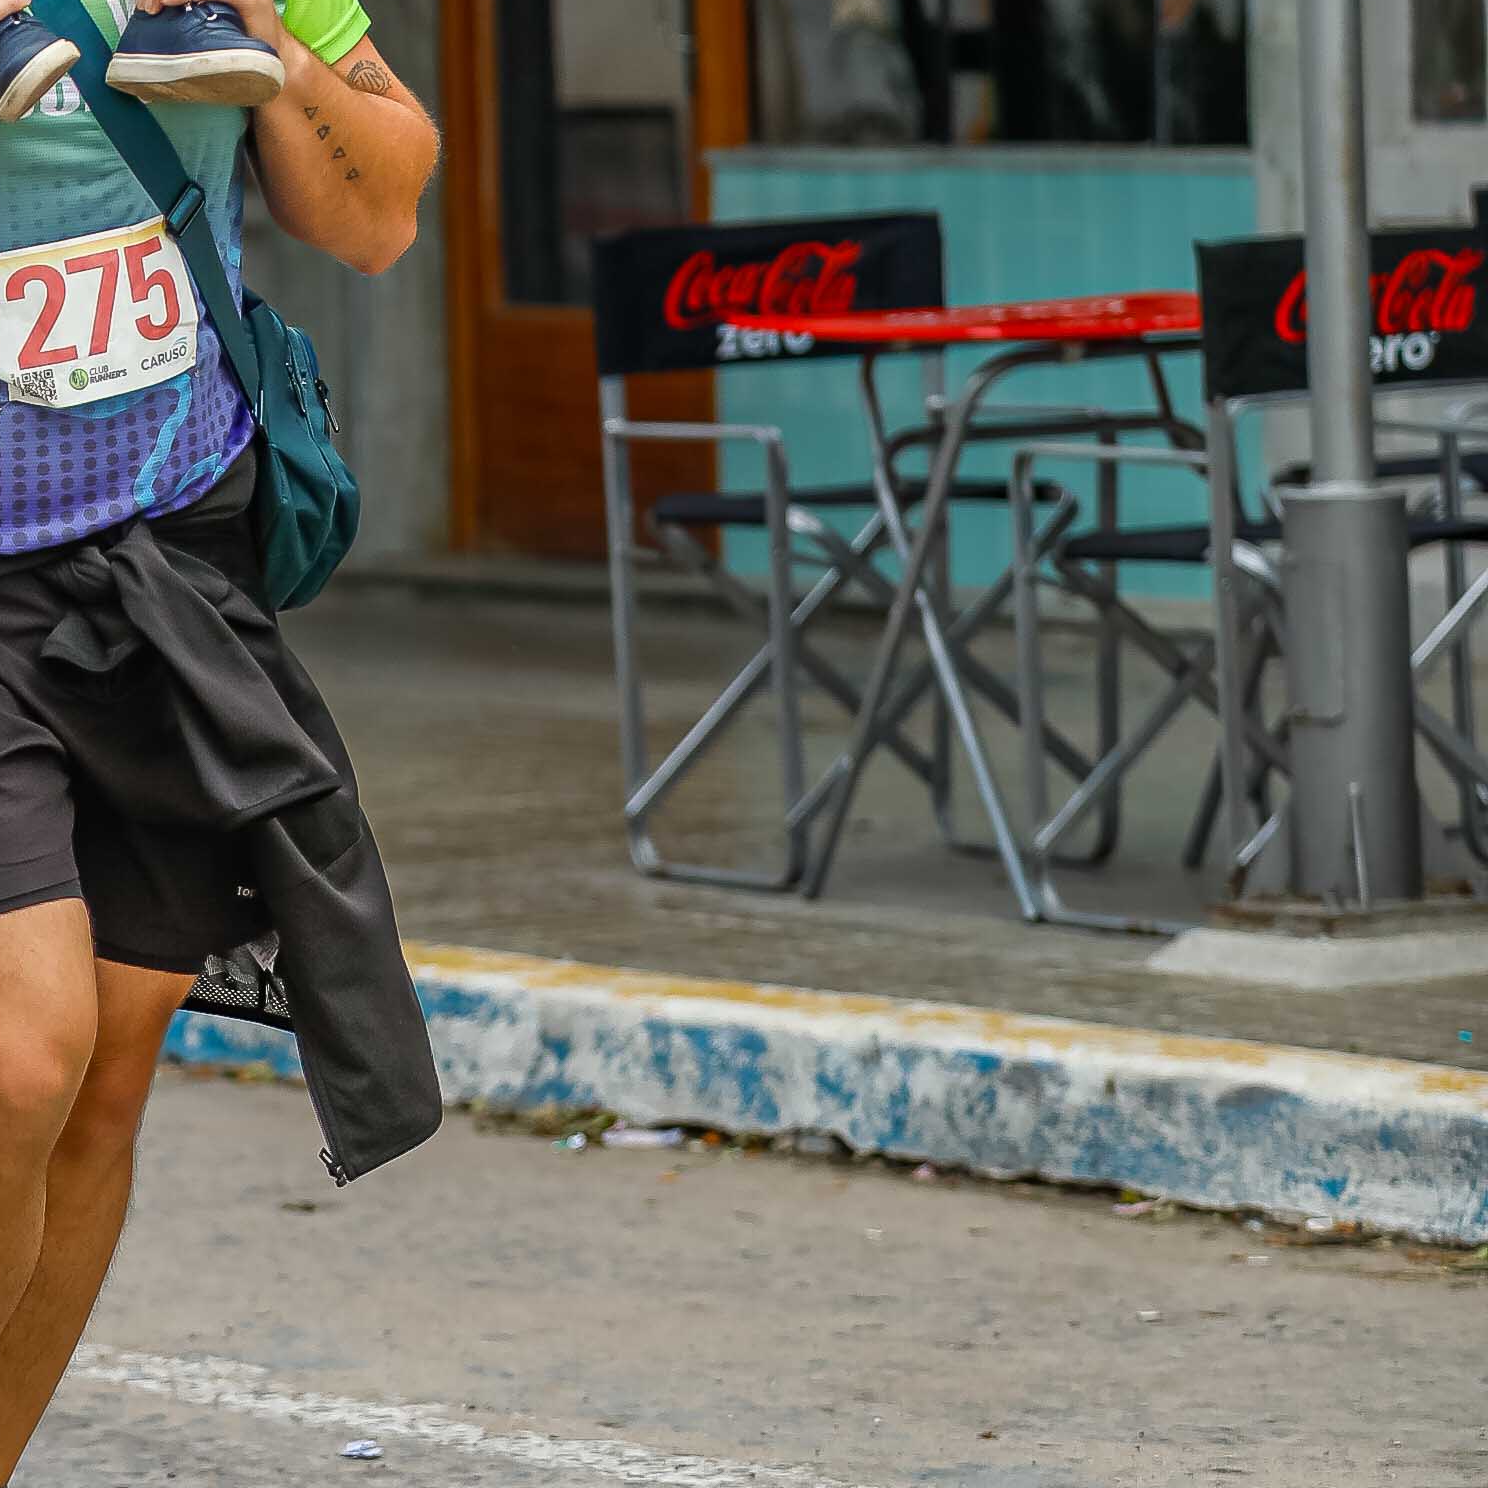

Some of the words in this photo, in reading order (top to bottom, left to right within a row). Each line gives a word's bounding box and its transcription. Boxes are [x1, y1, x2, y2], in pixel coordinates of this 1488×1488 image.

[5, 235, 181, 370] 275
[89, 364, 109, 376] CLUB
[140, 344, 188, 371] CARUSO
